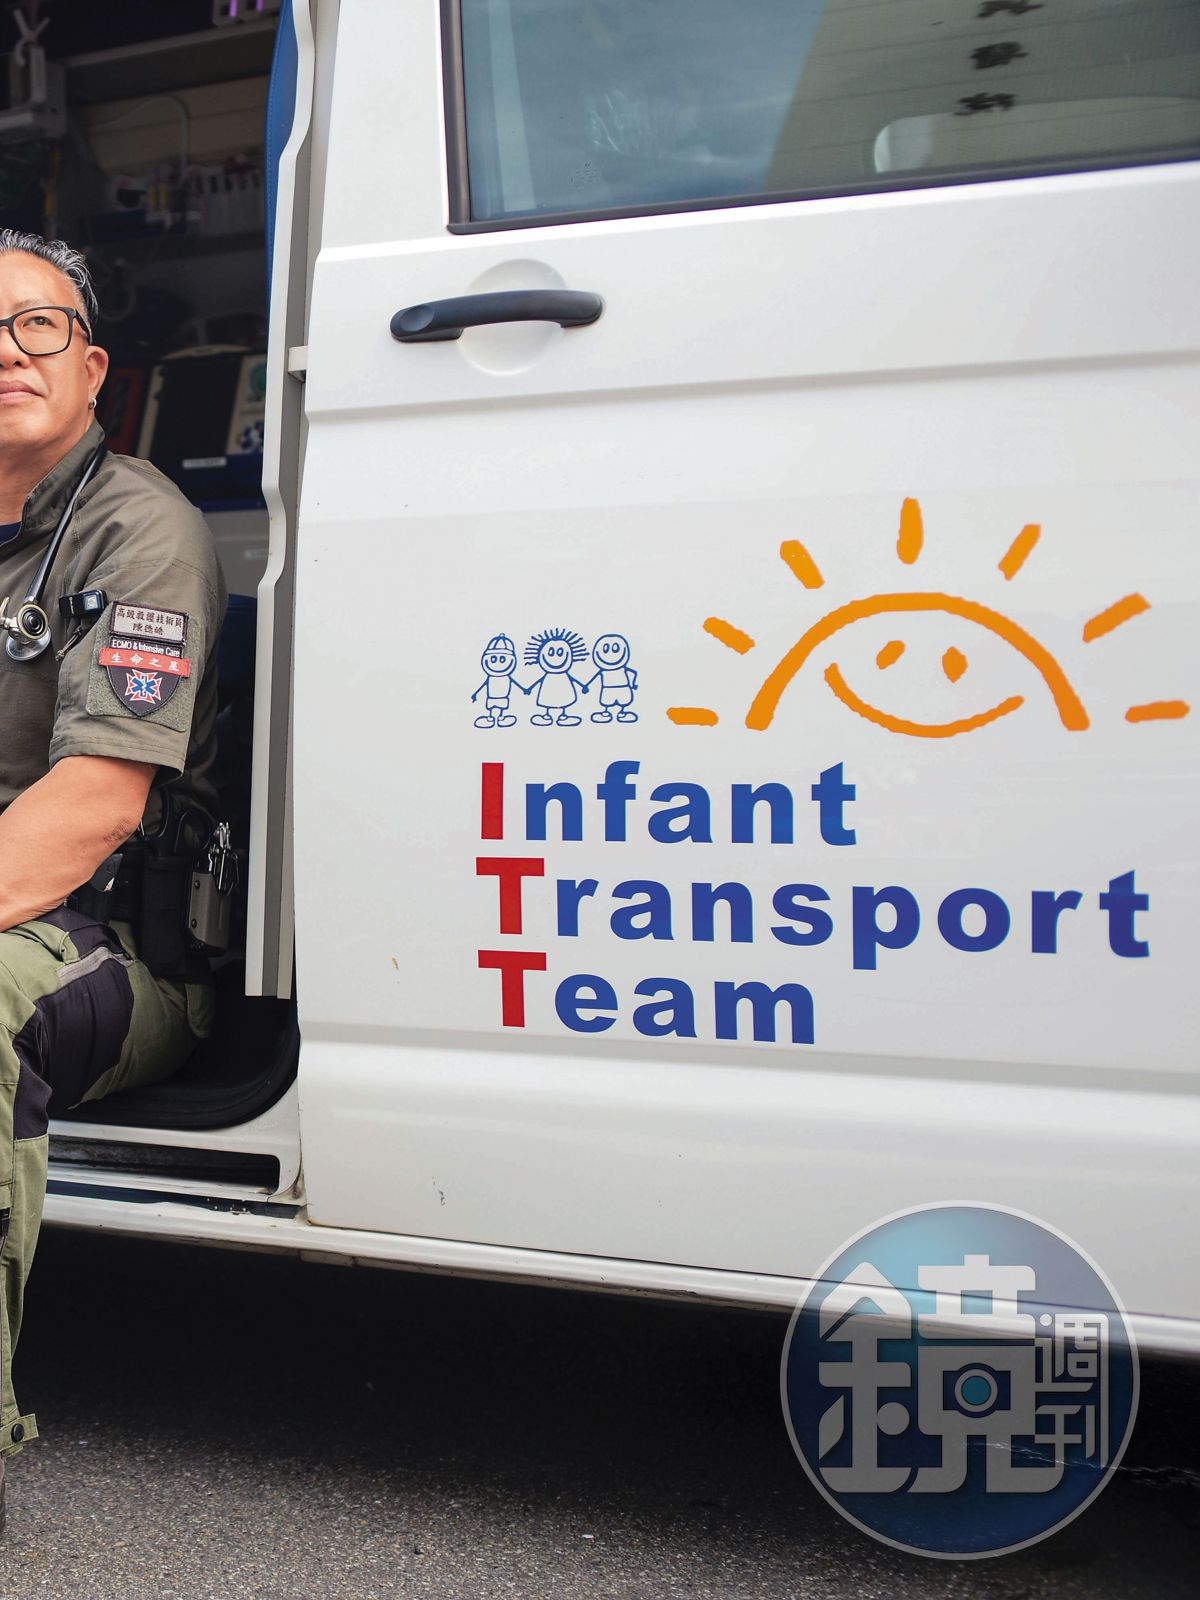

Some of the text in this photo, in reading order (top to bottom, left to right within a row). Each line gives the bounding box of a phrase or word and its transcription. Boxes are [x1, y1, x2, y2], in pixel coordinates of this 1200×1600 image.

[110, 652, 180, 672] 生命之星
[112, 640, 180, 658] ECMO & Intensive Care
[480, 760, 857, 847] Infant
[475, 856, 1150, 971] Transport
[477, 949, 816, 1045] Team
